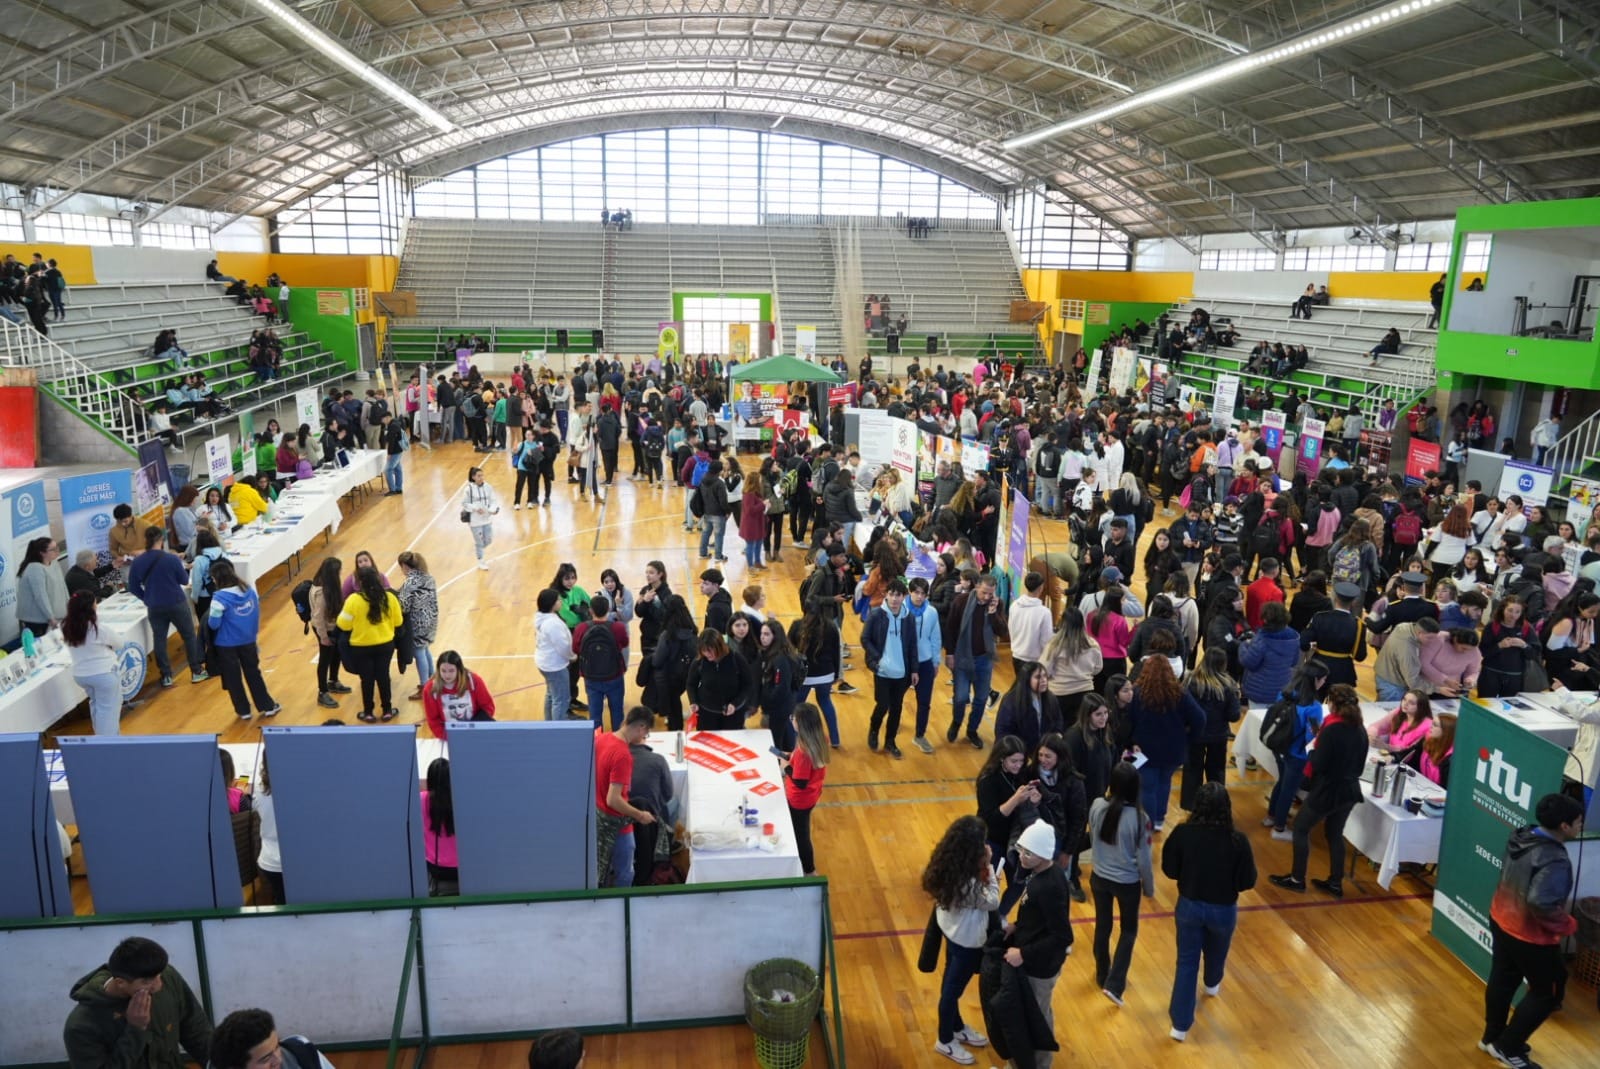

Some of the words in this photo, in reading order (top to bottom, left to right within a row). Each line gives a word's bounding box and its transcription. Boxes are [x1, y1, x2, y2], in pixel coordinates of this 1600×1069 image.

[756, 397, 784, 405] FUTURO
[79, 494, 99, 505] SABER
[1475, 746, 1532, 811] itu
[1473, 788, 1494, 806] INSTITUTO
[1475, 844, 1491, 862] SEDE
[1491, 855, 1503, 871] EST
